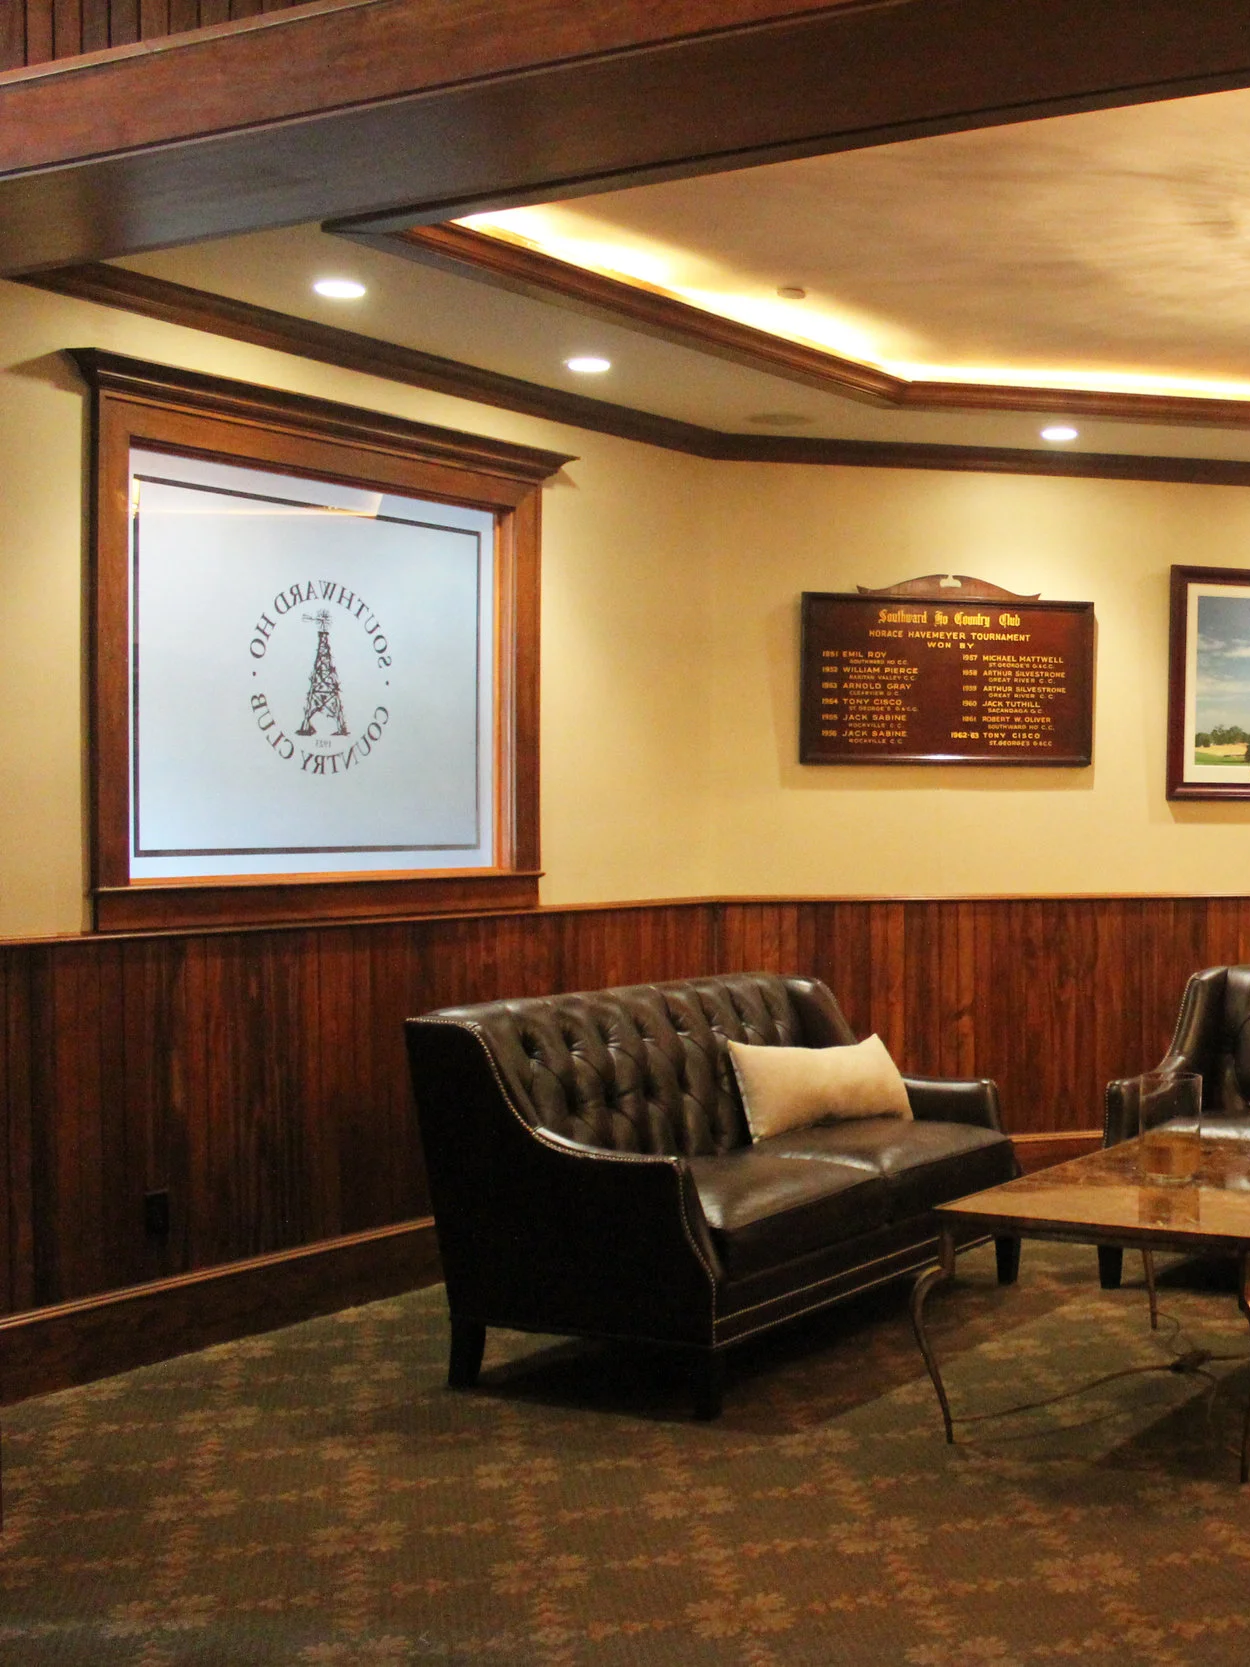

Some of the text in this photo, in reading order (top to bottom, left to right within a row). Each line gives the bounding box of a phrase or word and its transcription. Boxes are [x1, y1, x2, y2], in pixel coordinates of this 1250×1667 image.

[878, 609, 928, 624] Southward
[954, 612, 990, 628] Country
[998, 613, 1020, 628] Club
[869, 630, 1031, 642] HORACE HAVEMEYER TOURNAMENT
[1016, 670, 1066, 678] SILVESTRONE
[1016, 686, 1066, 694] SILVESTRONE
